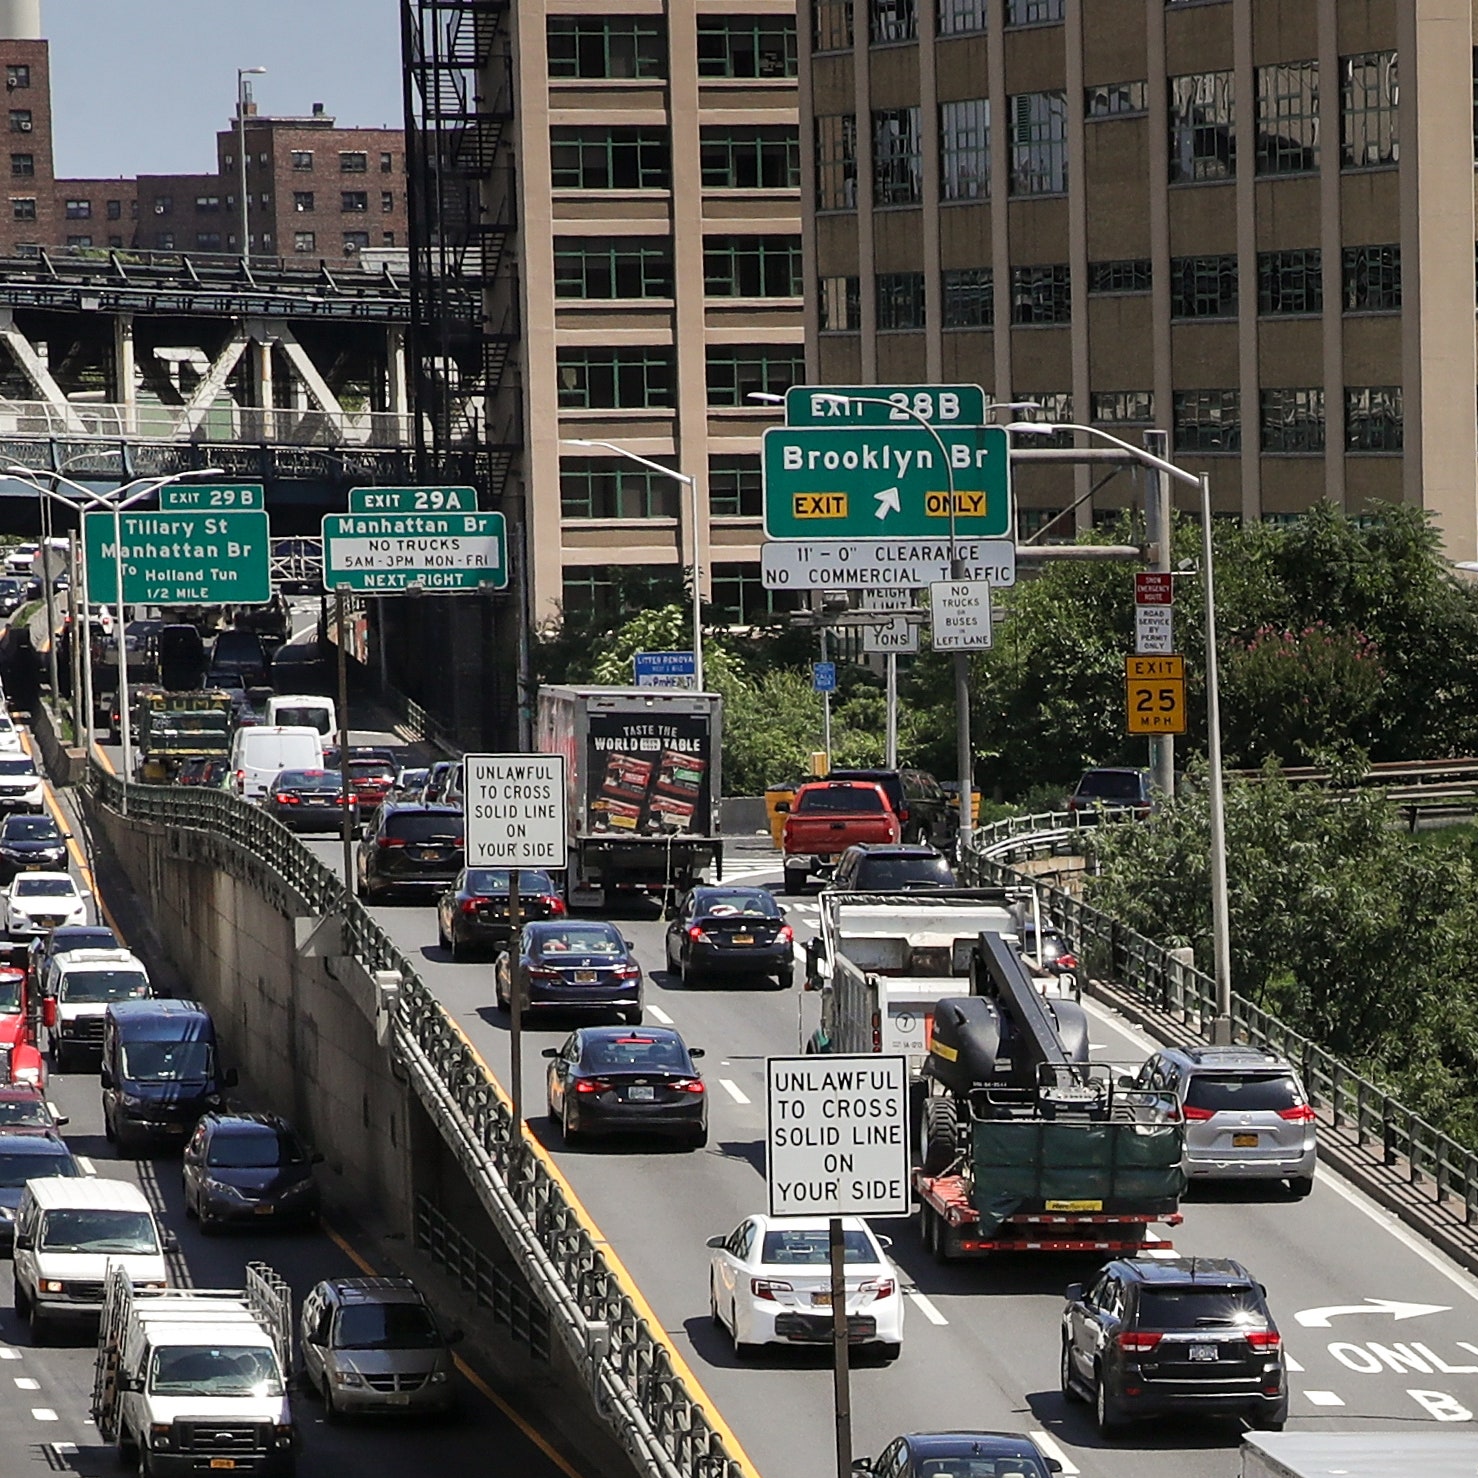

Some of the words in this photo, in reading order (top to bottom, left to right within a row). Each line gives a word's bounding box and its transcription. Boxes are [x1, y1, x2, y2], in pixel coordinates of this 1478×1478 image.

[889, 393, 960, 420] 28B
[783, 445, 933, 478] Brooklyn
[952, 445, 988, 468] Br
[170, 493, 200, 504] EXIT
[365, 495, 400, 507] EXIT
[415, 492, 461, 510] 29A
[795, 497, 844, 514] EXIT
[927, 495, 983, 513] ONLY
[125, 520, 194, 538] Tillary
[205, 519, 228, 534] St
[339, 517, 448, 533] Manhattan
[464, 517, 487, 532] Br
[101, 543, 218, 558] Manhattan
[228, 542, 251, 557] Br
[369, 540, 390, 551] NO
[397, 539, 460, 550] TRUCKS
[876, 546, 979, 561] CLEARANCE
[121, 563, 137, 575] To
[146, 569, 203, 581] Holland
[211, 569, 237, 580] Tun
[766, 569, 789, 583] NO
[809, 568, 921, 583] COMMERCIAL
[940, 567, 1010, 581] TAFFIC
[364, 574, 406, 586] NEXT
[417, 574, 463, 586] RIGHT
[147, 589, 169, 599] 1/2
[177, 588, 208, 598] MILE
[952, 587, 969, 595] NO
[943, 598, 980, 607] TRUCKS
[946, 618, 977, 626] BUSES
[874, 635, 908, 645] TONS
[936, 637, 957, 646] LEFT
[964, 636, 988, 645] LANE
[1136, 662, 1173, 674] EXIT
[1136, 689, 1175, 712] 25
[623, 725, 654, 736] TASTE
[658, 725, 678, 737] THE
[595, 738, 638, 750] WORLD
[663, 738, 700, 751] TABLE
[476, 766, 553, 779] UNLAWFUL
[480, 786, 497, 799] TO
[504, 786, 550, 799] CROSS
[475, 805, 517, 818] SOLID
[525, 805, 555, 818] LINE
[507, 824, 525, 837] ON
[478, 843, 515, 856] YOUR
[523, 843, 554, 856] SIDE
[776, 1072, 898, 1091] UNLAWFUL
[778, 1100, 805, 1119] TO
[823, 1099, 897, 1118] CROSS
[775, 1127, 840, 1146] SOLID
[853, 1126, 900, 1144] LINE
[825, 1154, 853, 1172] ON
[778, 1182, 838, 1201] YOUR
[852, 1180, 900, 1199] SIDE
